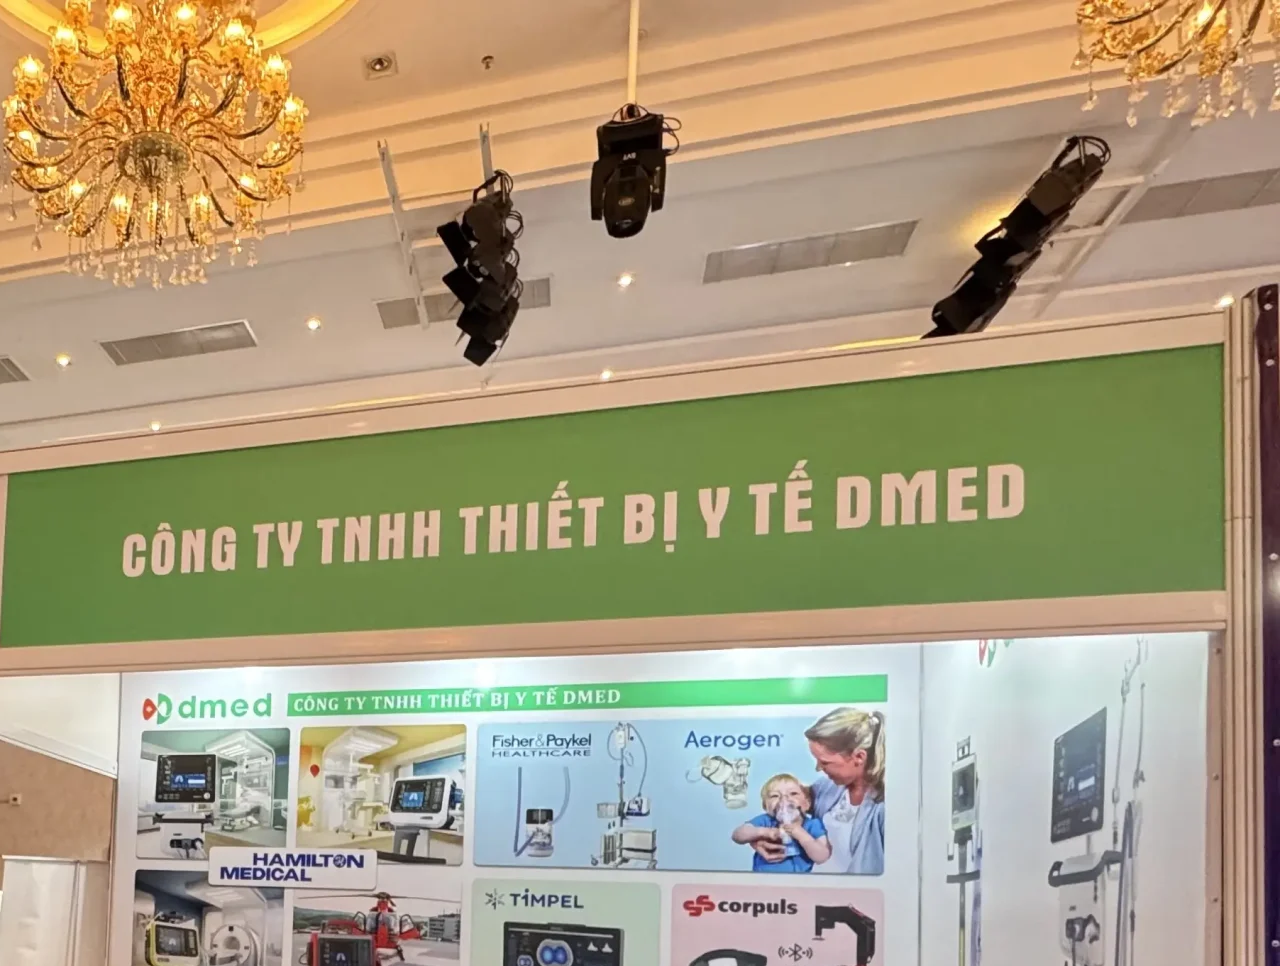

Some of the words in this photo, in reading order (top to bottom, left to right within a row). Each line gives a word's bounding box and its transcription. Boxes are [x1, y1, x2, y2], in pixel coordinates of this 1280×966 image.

[121, 522, 237, 578] CÔNG
[253, 520, 303, 570] TY
[316, 509, 441, 566] TNHH
[459, 480, 605, 555] THIẾT
[623, 490, 678, 553] BỊ
[698, 486, 731, 539] Y
[748, 459, 814, 536] TẾ
[836, 463, 1025, 530] DMED
[177, 692, 272, 719] dmed
[293, 695, 339, 712] CÔNG
[344, 697, 367, 710] TY
[371, 694, 422, 710] TNHH
[427, 687, 486, 709] THIẾT
[490, 691, 510, 710] BỊ
[516, 691, 528, 707] Y
[533, 686, 558, 706] TẾ
[563, 688, 622, 706] DMED
[684, 730, 781, 751] Aerogen
[492, 748, 591, 758] HEALTHCARE
[253, 852, 365, 869] HAMILTON
[220, 866, 312, 882] MEDICAL
[717, 898, 798, 917] corpuls
